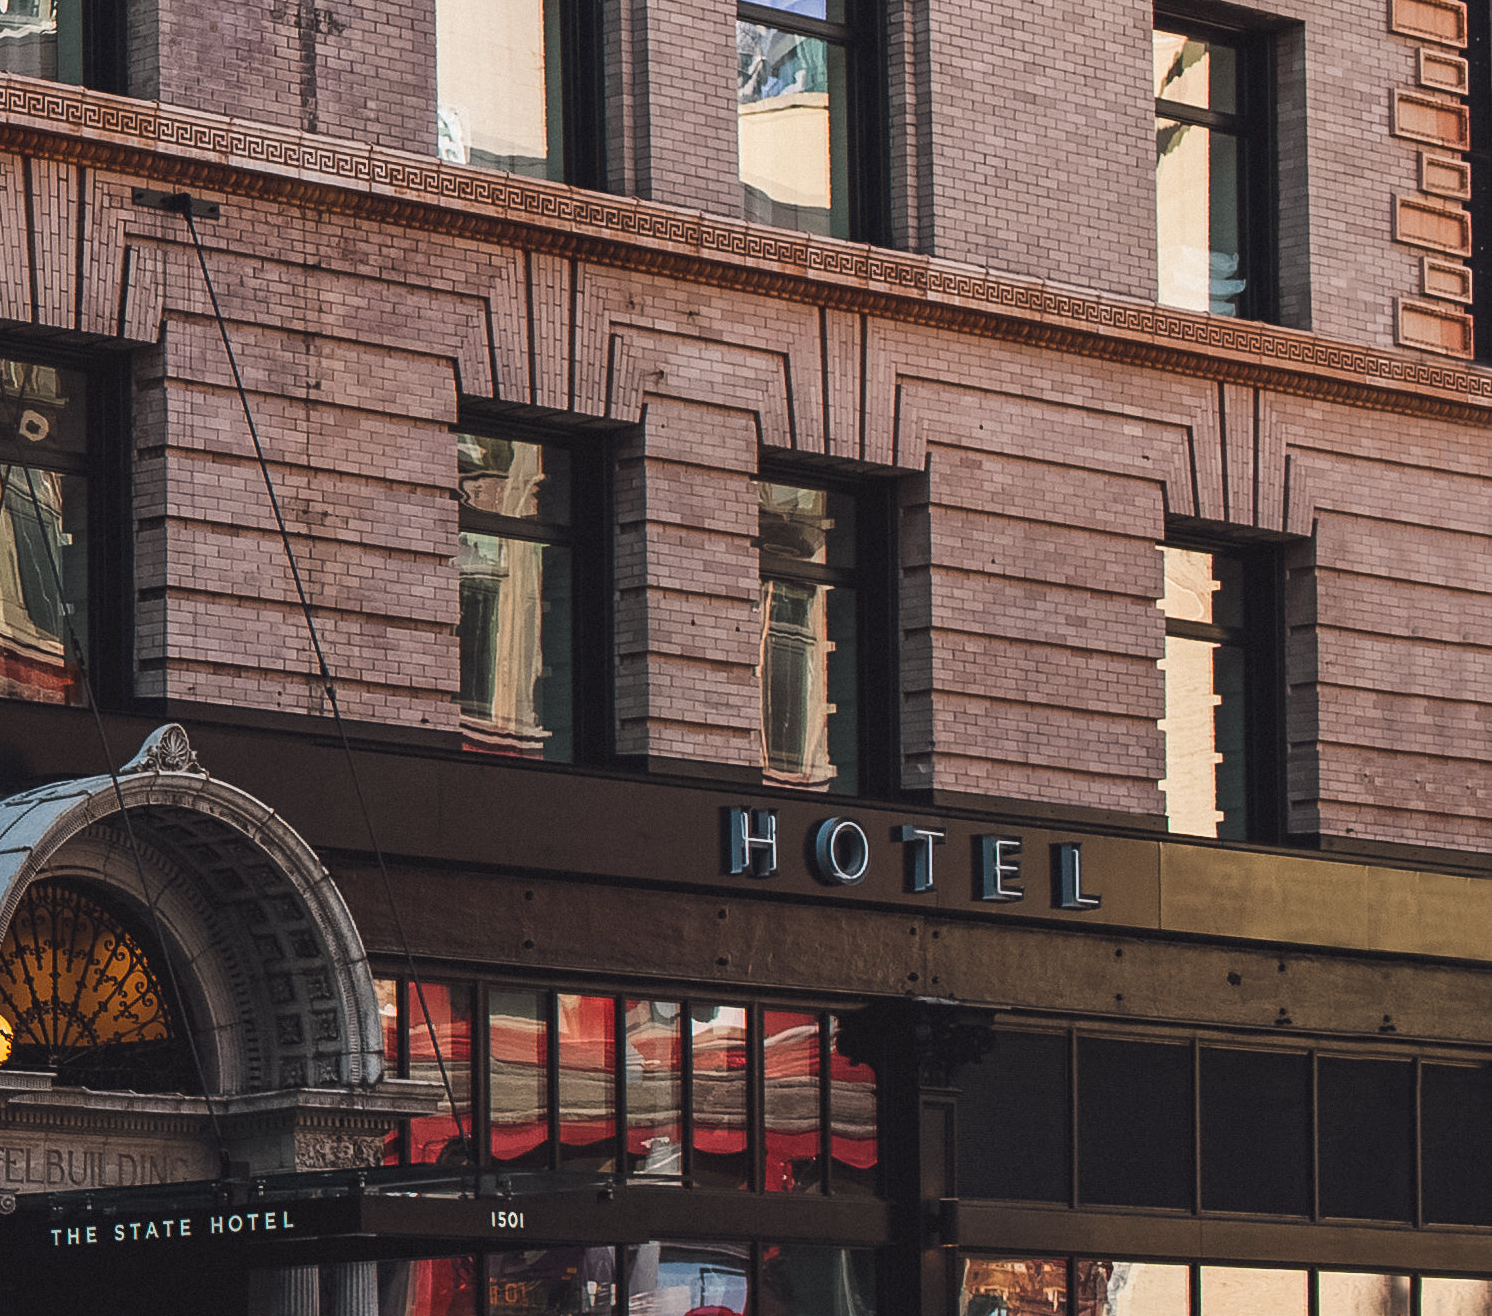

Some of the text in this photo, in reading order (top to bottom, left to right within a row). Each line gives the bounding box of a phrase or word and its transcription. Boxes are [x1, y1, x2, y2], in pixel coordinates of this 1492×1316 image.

[721, 805, 1102, 911] HOTEL
[50, 1210, 296, 1247] THE STATE HOTEL
[489, 1209, 526, 1230] 1501
